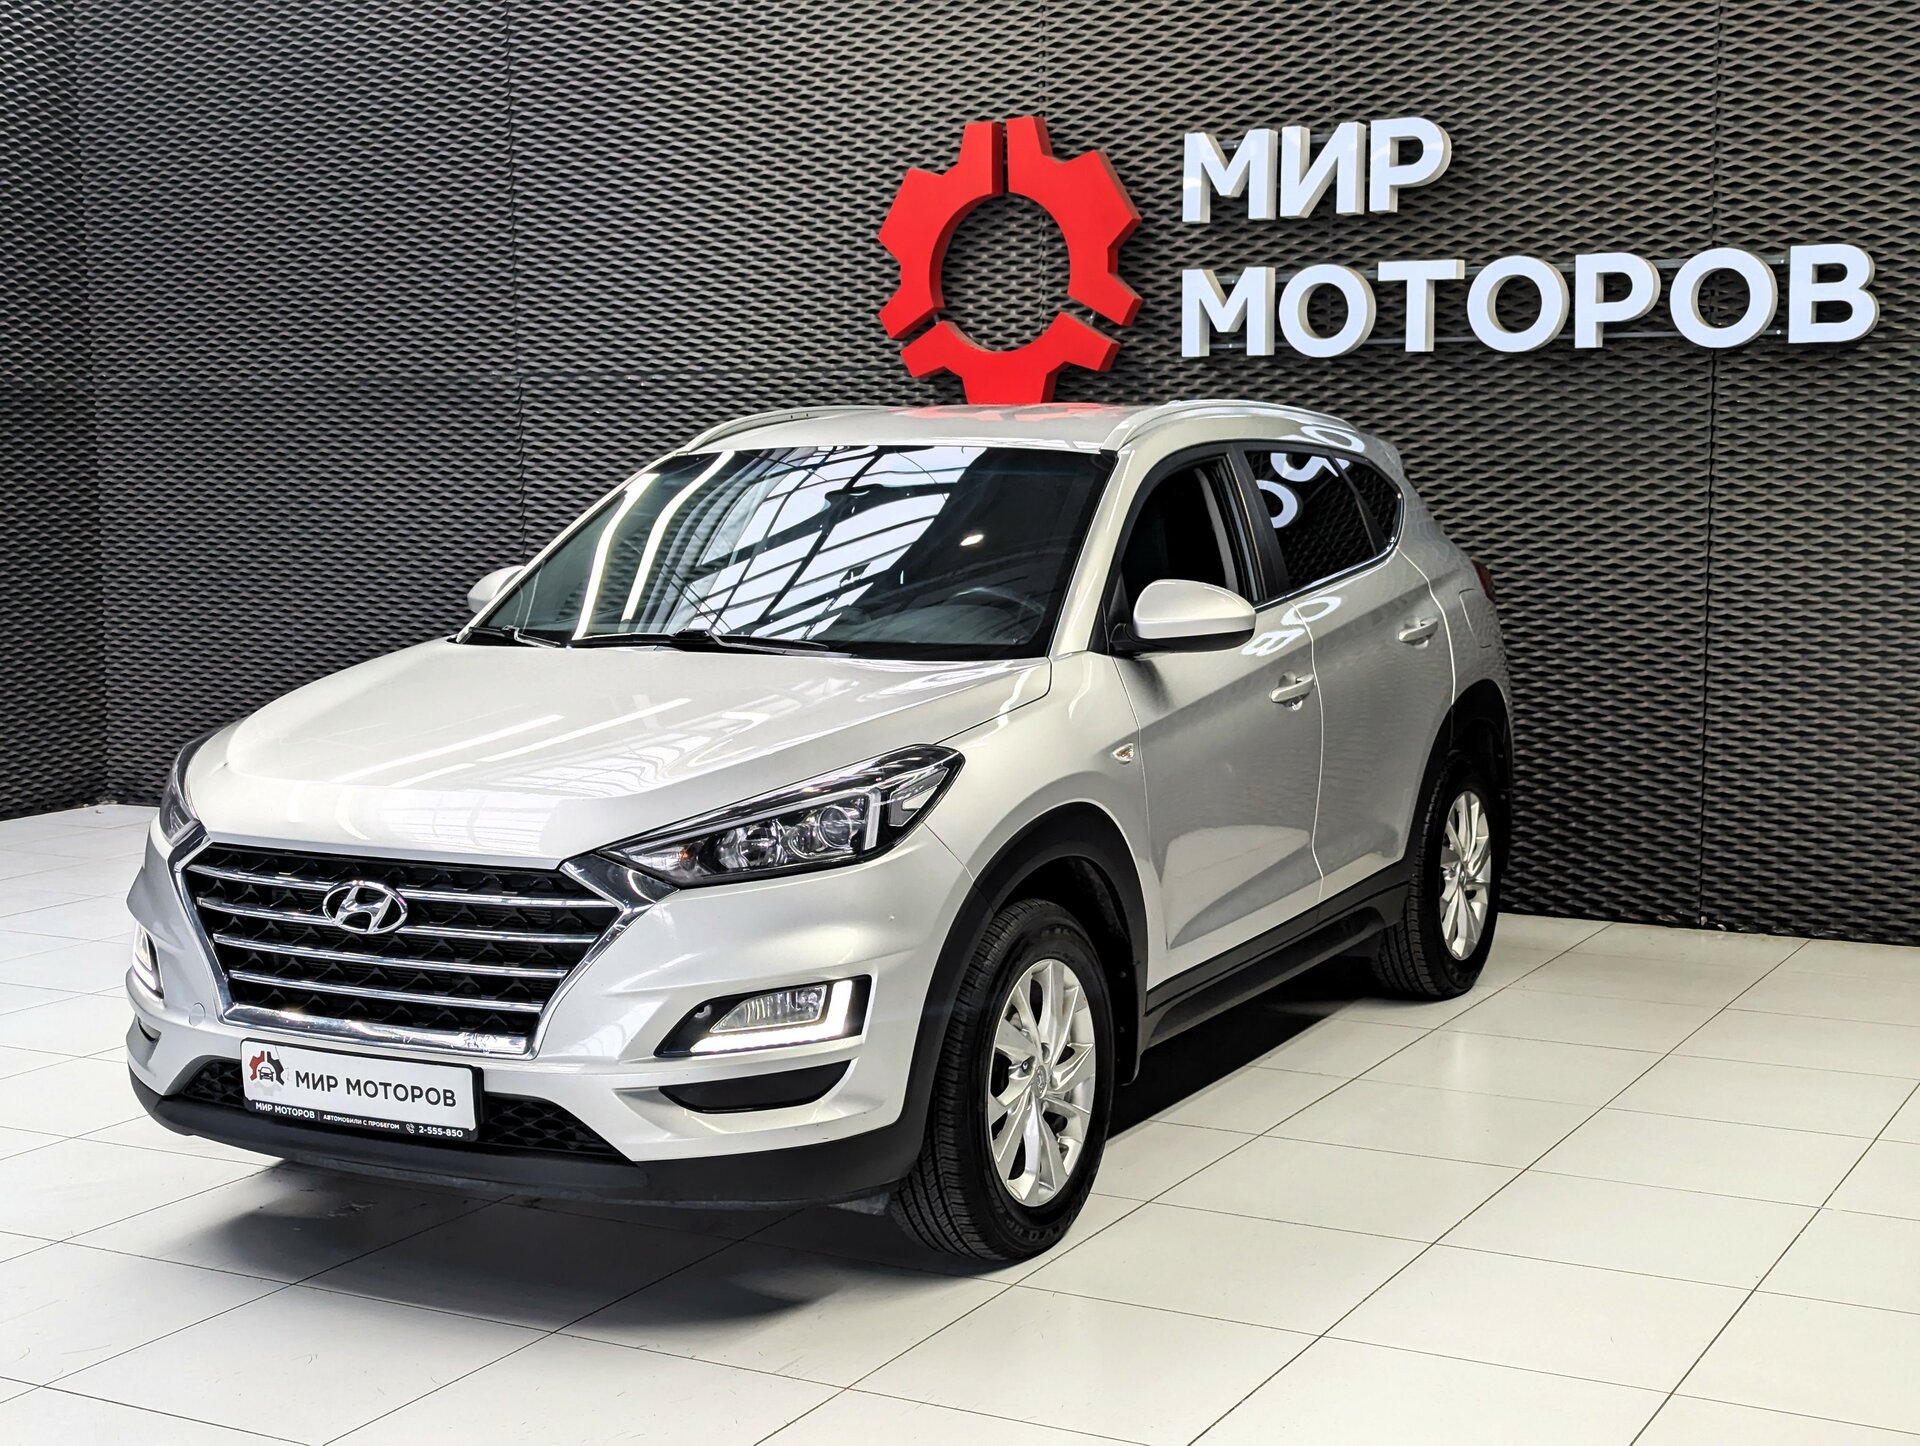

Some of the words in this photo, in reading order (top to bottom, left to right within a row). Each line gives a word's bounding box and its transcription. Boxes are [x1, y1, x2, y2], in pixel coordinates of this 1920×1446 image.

[1182, 116, 1452, 224] МИР
[1181, 243, 1880, 358] МОТОРОВ
[255, 1101, 273, 1112] МИР
[274, 1104, 316, 1119] МОТОРОВ
[322, 1114, 362, 1125] АВТОМОБИЛИ
[368, 1120, 400, 1130] ПРОБЕГОМ
[418, 1125, 464, 1138] 2-555-850
[295, 1070, 338, 1092] МИР
[345, 1077, 457, 1108] МОТОРОВ
